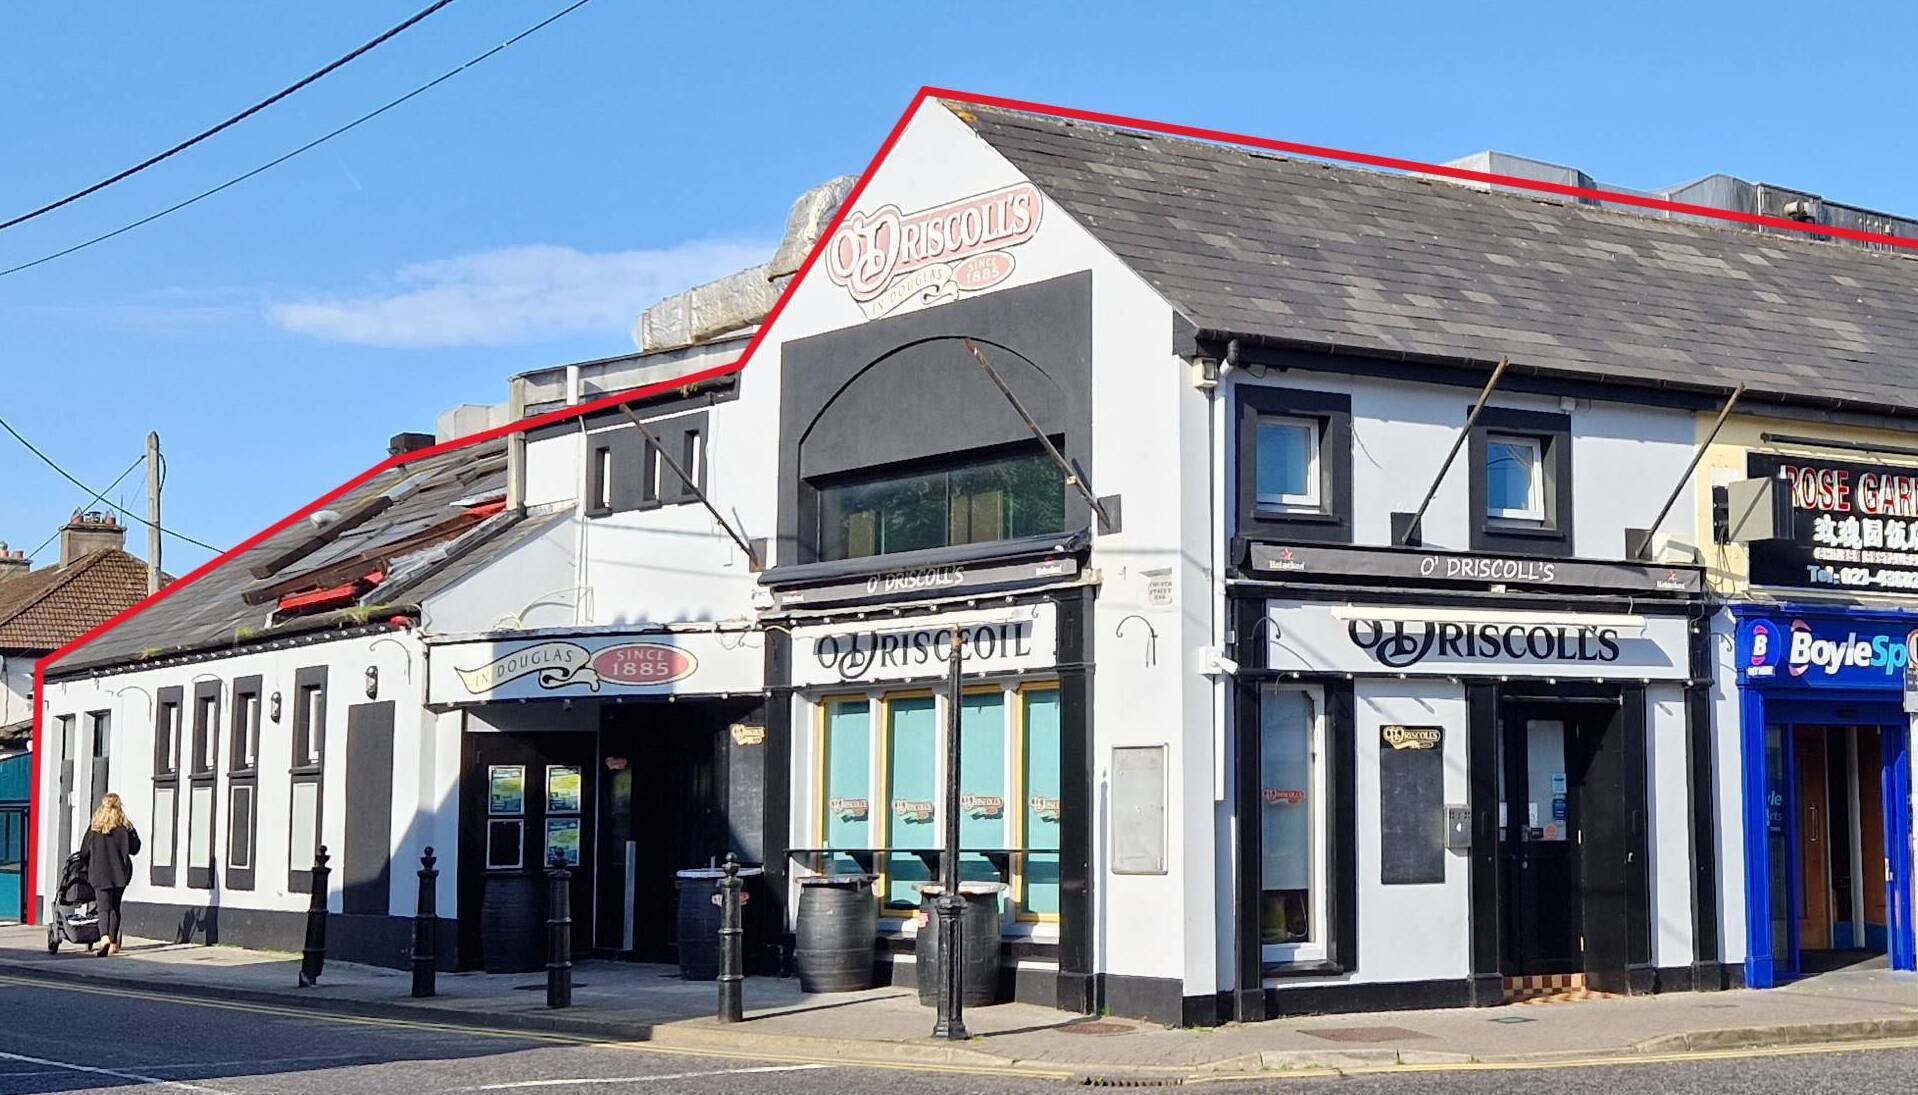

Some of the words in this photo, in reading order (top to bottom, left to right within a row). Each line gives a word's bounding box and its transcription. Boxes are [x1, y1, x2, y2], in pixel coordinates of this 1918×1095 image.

[967, 256, 997, 272] SINCE
[890, 268, 943, 303] DOUGLAS
[966, 267, 1000, 284] 1885
[1858, 472, 1918, 517] GAR
[1447, 558, 1555, 581] DRISCOLL'S
[616, 649, 665, 662] SINCE
[474, 672, 489, 687] IN
[497, 649, 573, 678] DOUGLAS
[612, 662, 670, 676] 1885
